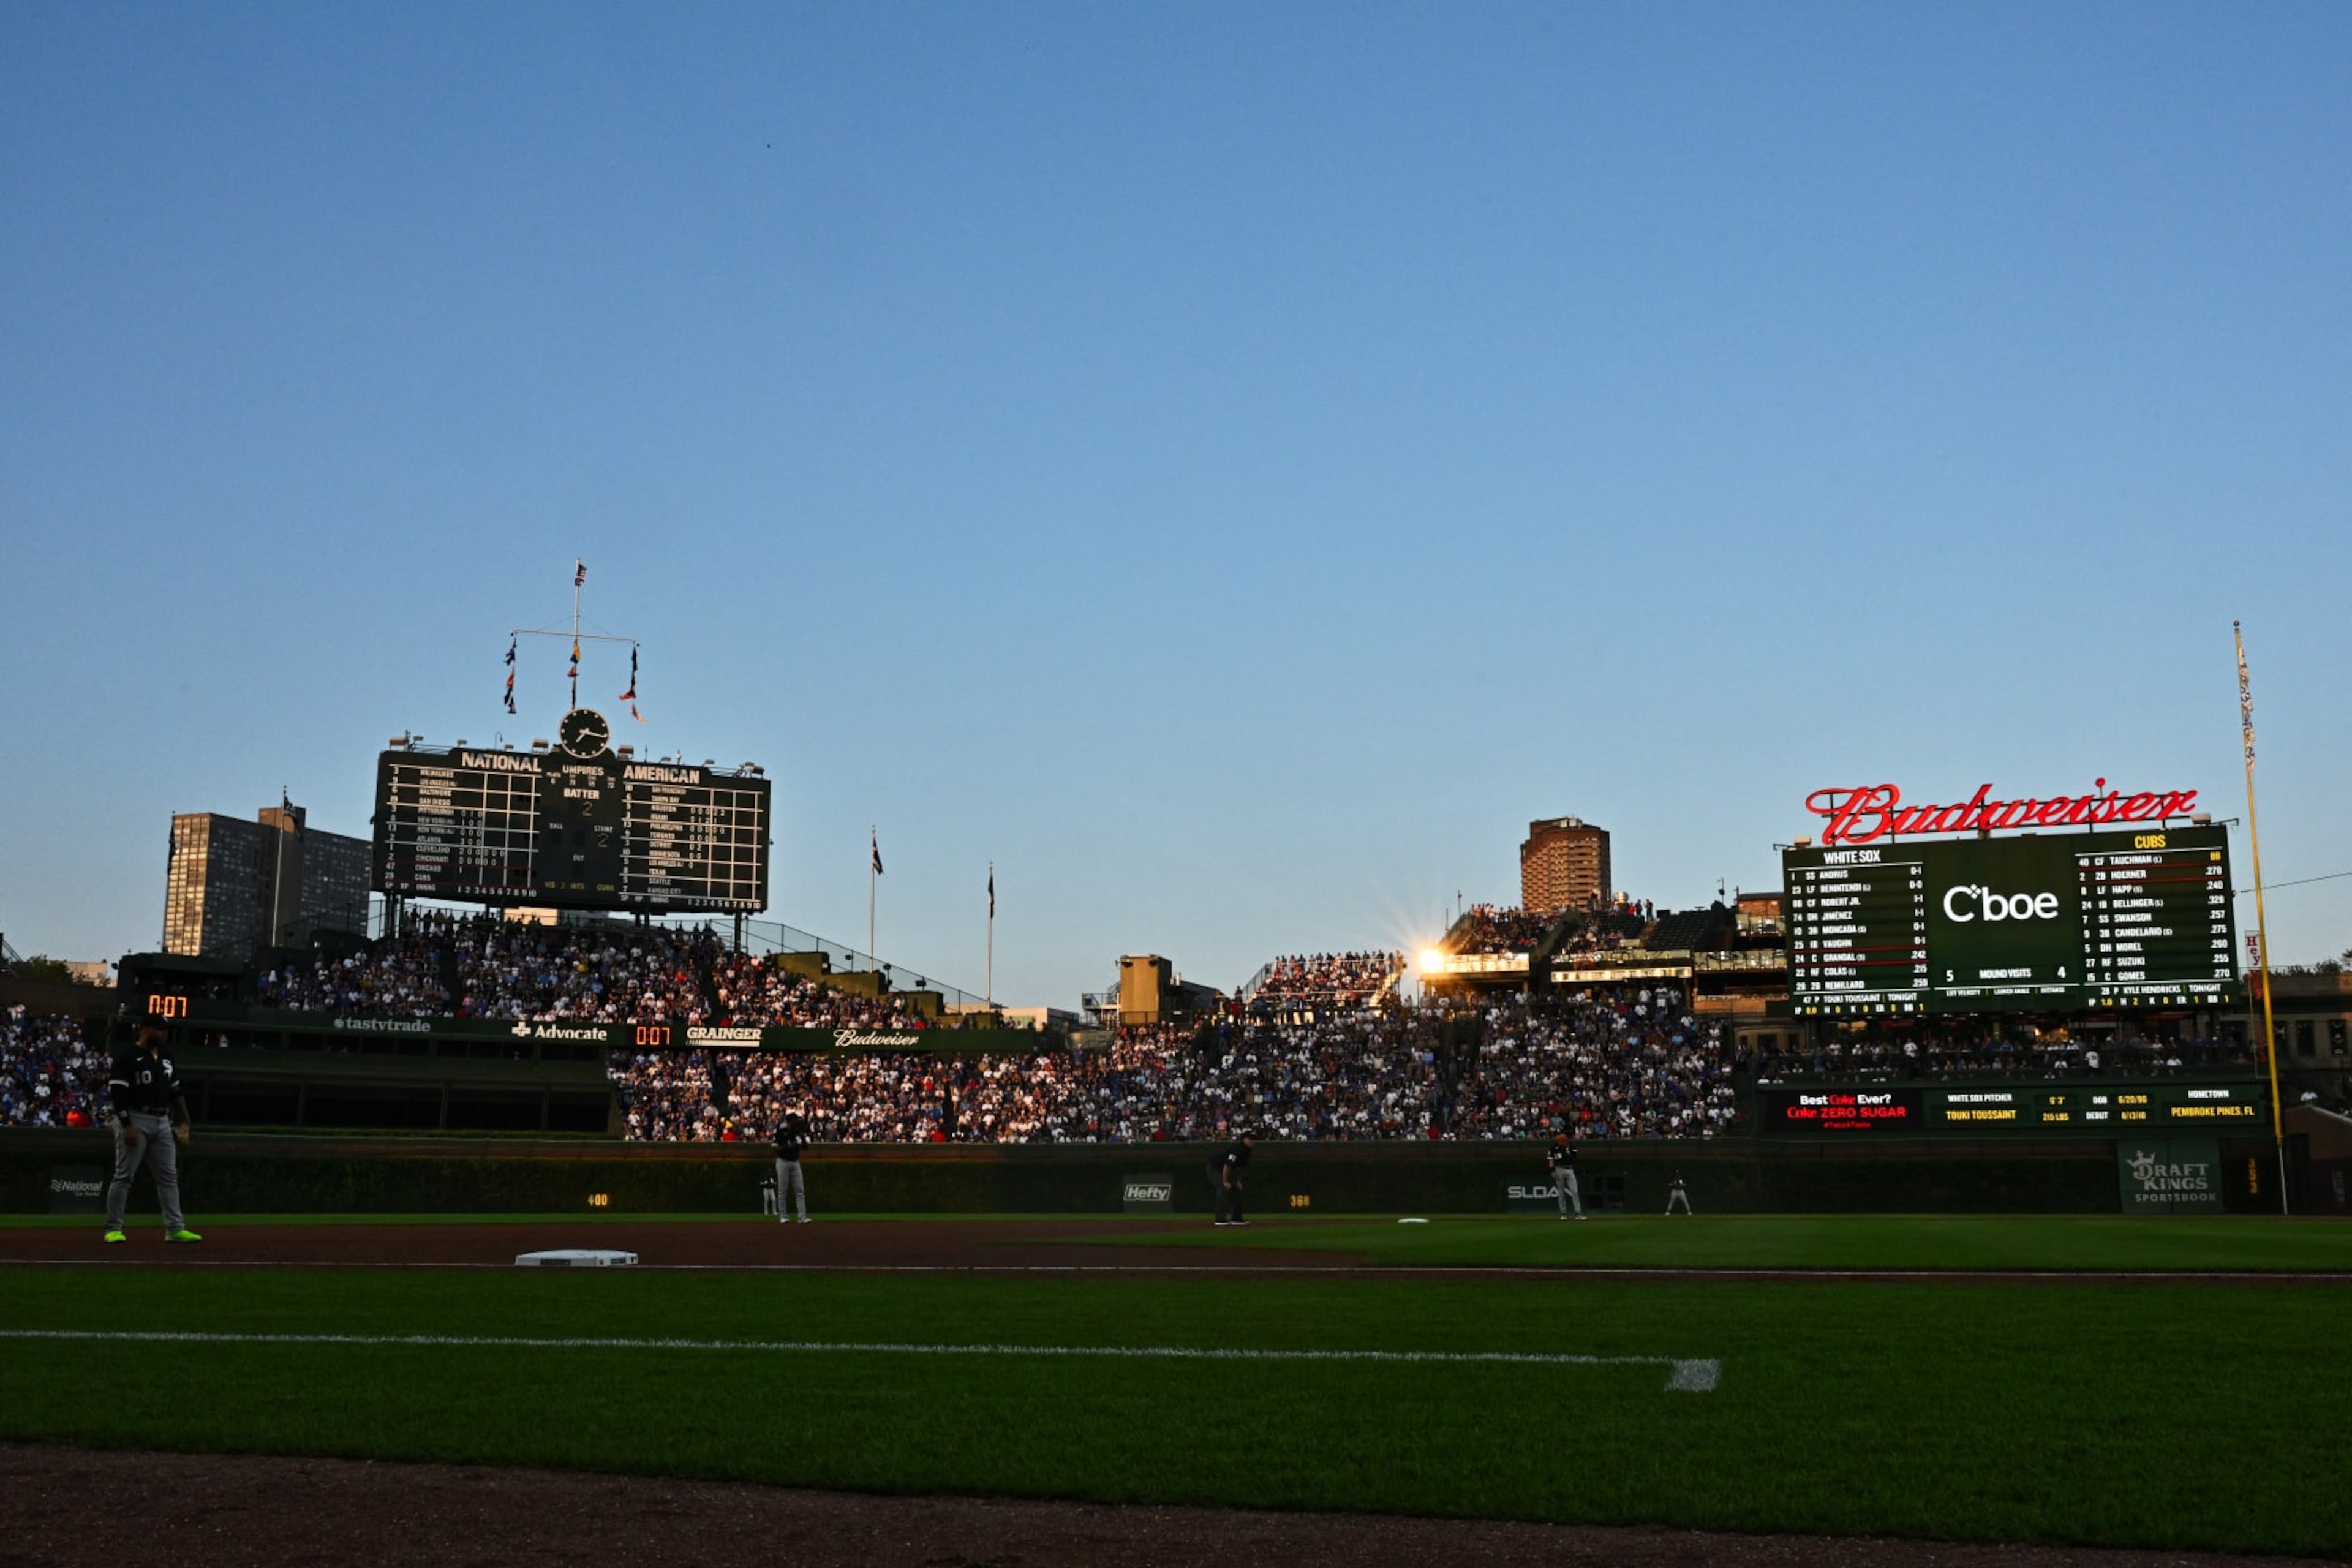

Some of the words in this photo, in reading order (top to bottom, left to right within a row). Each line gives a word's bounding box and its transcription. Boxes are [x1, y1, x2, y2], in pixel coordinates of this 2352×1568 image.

[462, 752, 542, 772] NATIONAL
[562, 764, 605, 776] UMPIRES
[624, 765, 700, 784] AMERICAN
[564, 788, 599, 799] BATTER
[582, 801, 592, 816] 2
[1805, 777, 2198, 846] Budweiser
[598, 833, 608, 847] 2
[2135, 835, 2166, 848] CUBS
[416, 845, 450, 854] CLEVELAND
[1824, 851, 1858, 864] WHITE
[1859, 850, 1880, 862] SOX
[2079, 858, 2089, 867] 40
[2095, 857, 2105, 866] CF
[2110, 855, 2152, 865] TAUCHMAN
[1806, 872, 1815, 880] SS
[1820, 870, 1848, 879] ANDRUS
[2079, 872, 2085, 881] 2
[2095, 871, 2106, 880] 2B
[2111, 870, 2146, 879] HOERNER
[1792, 886, 1801, 894] 23
[1807, 885, 1816, 894] LF
[1820, 883, 1861, 893] BENINTENDI
[2097, 886, 2106, 895] LF
[2113, 885, 2132, 894] HAPP
[1807, 899, 1816, 907] CF
[1821, 897, 1848, 907] ROBERT
[1849, 897, 1861, 906] JR.
[1943, 884, 2059, 922] Cboe
[2082, 901, 2092, 910] 24
[2113, 899, 2154, 908] BELLINGER
[1793, 913, 1803, 922] 74
[2082, 915, 2088, 924] 7
[2098, 914, 2109, 923] SS
[2114, 913, 2152, 922] SWANSON
[1822, 925, 1856, 934] MONCADA
[2114, 927, 2162, 937] CANDELARIO
[1795, 941, 1804, 949] 25
[1823, 939, 1852, 948] VAUGHN
[2084, 944, 2090, 952] 5
[2100, 943, 2111, 952] DH
[2116, 942, 2143, 951] MOREL
[1795, 954, 1804, 963] 24
[1812, 954, 1817, 962] C
[1823, 953, 1856, 962] GRANDAL
[2086, 959, 2095, 967] 27
[2102, 958, 2111, 967] RF
[2117, 957, 2145, 966] SUZUKI
[1796, 968, 1805, 977] 22
[1946, 970, 1954, 982] 5
[1979, 969, 2007, 979] MOUND
[2008, 968, 2031, 978] VISITS
[2058, 966, 2066, 978] 4
[2087, 973, 2095, 982] 15
[2105, 973, 2111, 981] C
[2117, 971, 2145, 981] GOMES
[1825, 980, 1864, 990] REMILLARD
[2123, 986, 2139, 994] KYLE
[2141, 985, 2181, 993] HENDRICKS
[2189, 984, 2221, 992] TONIGHT
[1824, 994, 1844, 1003] TOUKI
[1845, 993, 1880, 1003] TOUSSAINT
[1888, 992, 1917, 1001] TONIGHT
[2194, 995, 2199, 1004] 1
[2225, 995, 2229, 1003] 1
[345, 1017, 431, 1033] tastytrade
[535, 1025, 607, 1041] Advocate
[636, 1026, 670, 1045] 0:07
[687, 1027, 763, 1041] GRAINGER
[833, 1029, 920, 1047] Budweiser
[135, 1070, 152, 1085] 10
[1800, 1095, 1828, 1106] Best
[1829, 1094, 1856, 1104] Coke
[1857, 1093, 1891, 1104] Ever?
[1983, 1093, 2012, 1102] PITCHER
[2092, 1096, 2108, 1104] DOB
[2117, 1095, 2147, 1104] 6/20/96
[2188, 1090, 2229, 1099] HOMETOWN
[1787, 1107, 1817, 1119] Coke
[1820, 1107, 1856, 1118] ZERO
[1860, 1107, 1906, 1118] SUGAR
[1947, 1110, 1970, 1120] TOUKI
[1972, 1110, 2016, 1119] TOUSSAINT
[2171, 1106, 2215, 1116] PEMBROKE
[2217, 1106, 2243, 1116] PINES,
[2244, 1106, 2255, 1115] FL
[2133, 1164, 2209, 1180] DRAFT
[62, 1180, 103, 1191] National
[2143, 1177, 2209, 1191] KINGS
[1126, 1186, 1168, 1201] Hefty
[2135, 1193, 2217, 1202] SPORTSBOOK
[587, 1193, 608, 1207] 400
